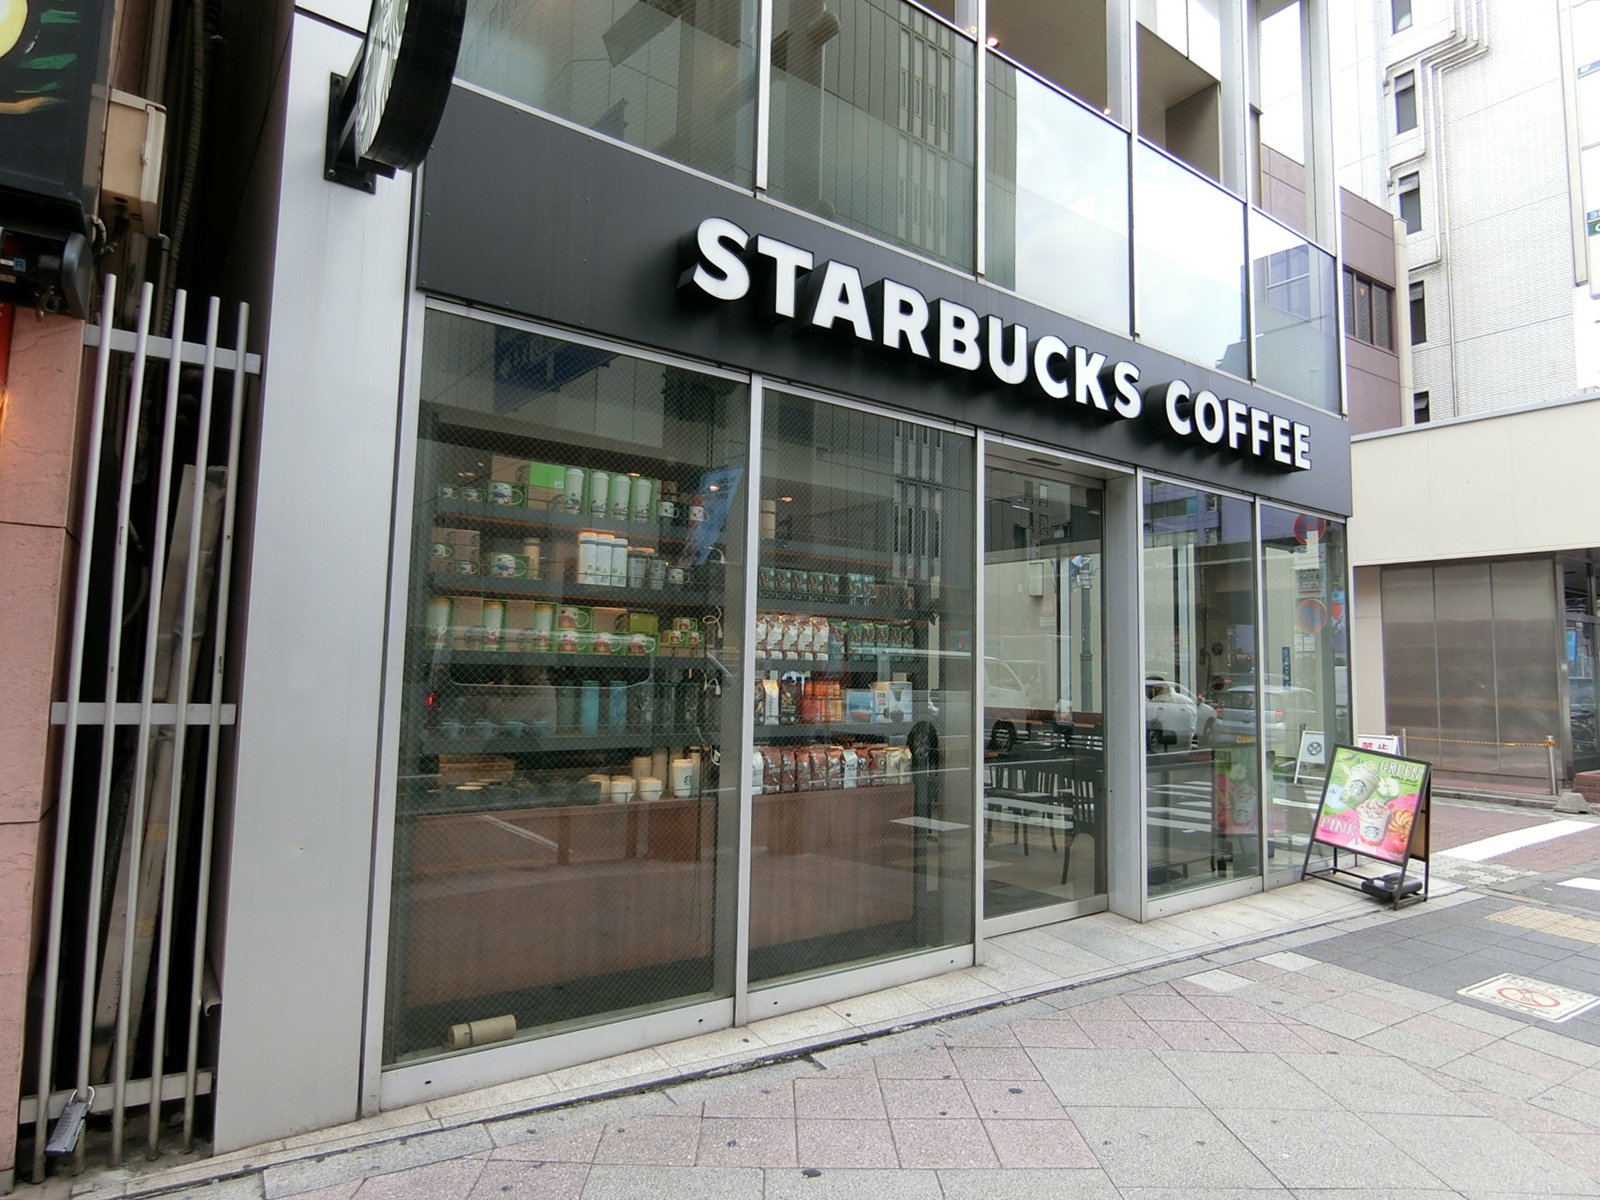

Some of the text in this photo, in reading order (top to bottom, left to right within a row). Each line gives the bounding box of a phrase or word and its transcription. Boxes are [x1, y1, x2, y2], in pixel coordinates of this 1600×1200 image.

[692, 217, 1312, 470] STARBUCKS COFFEE
[1379, 759, 1422, 779] GREEN
[1320, 817, 1357, 836] PINK
